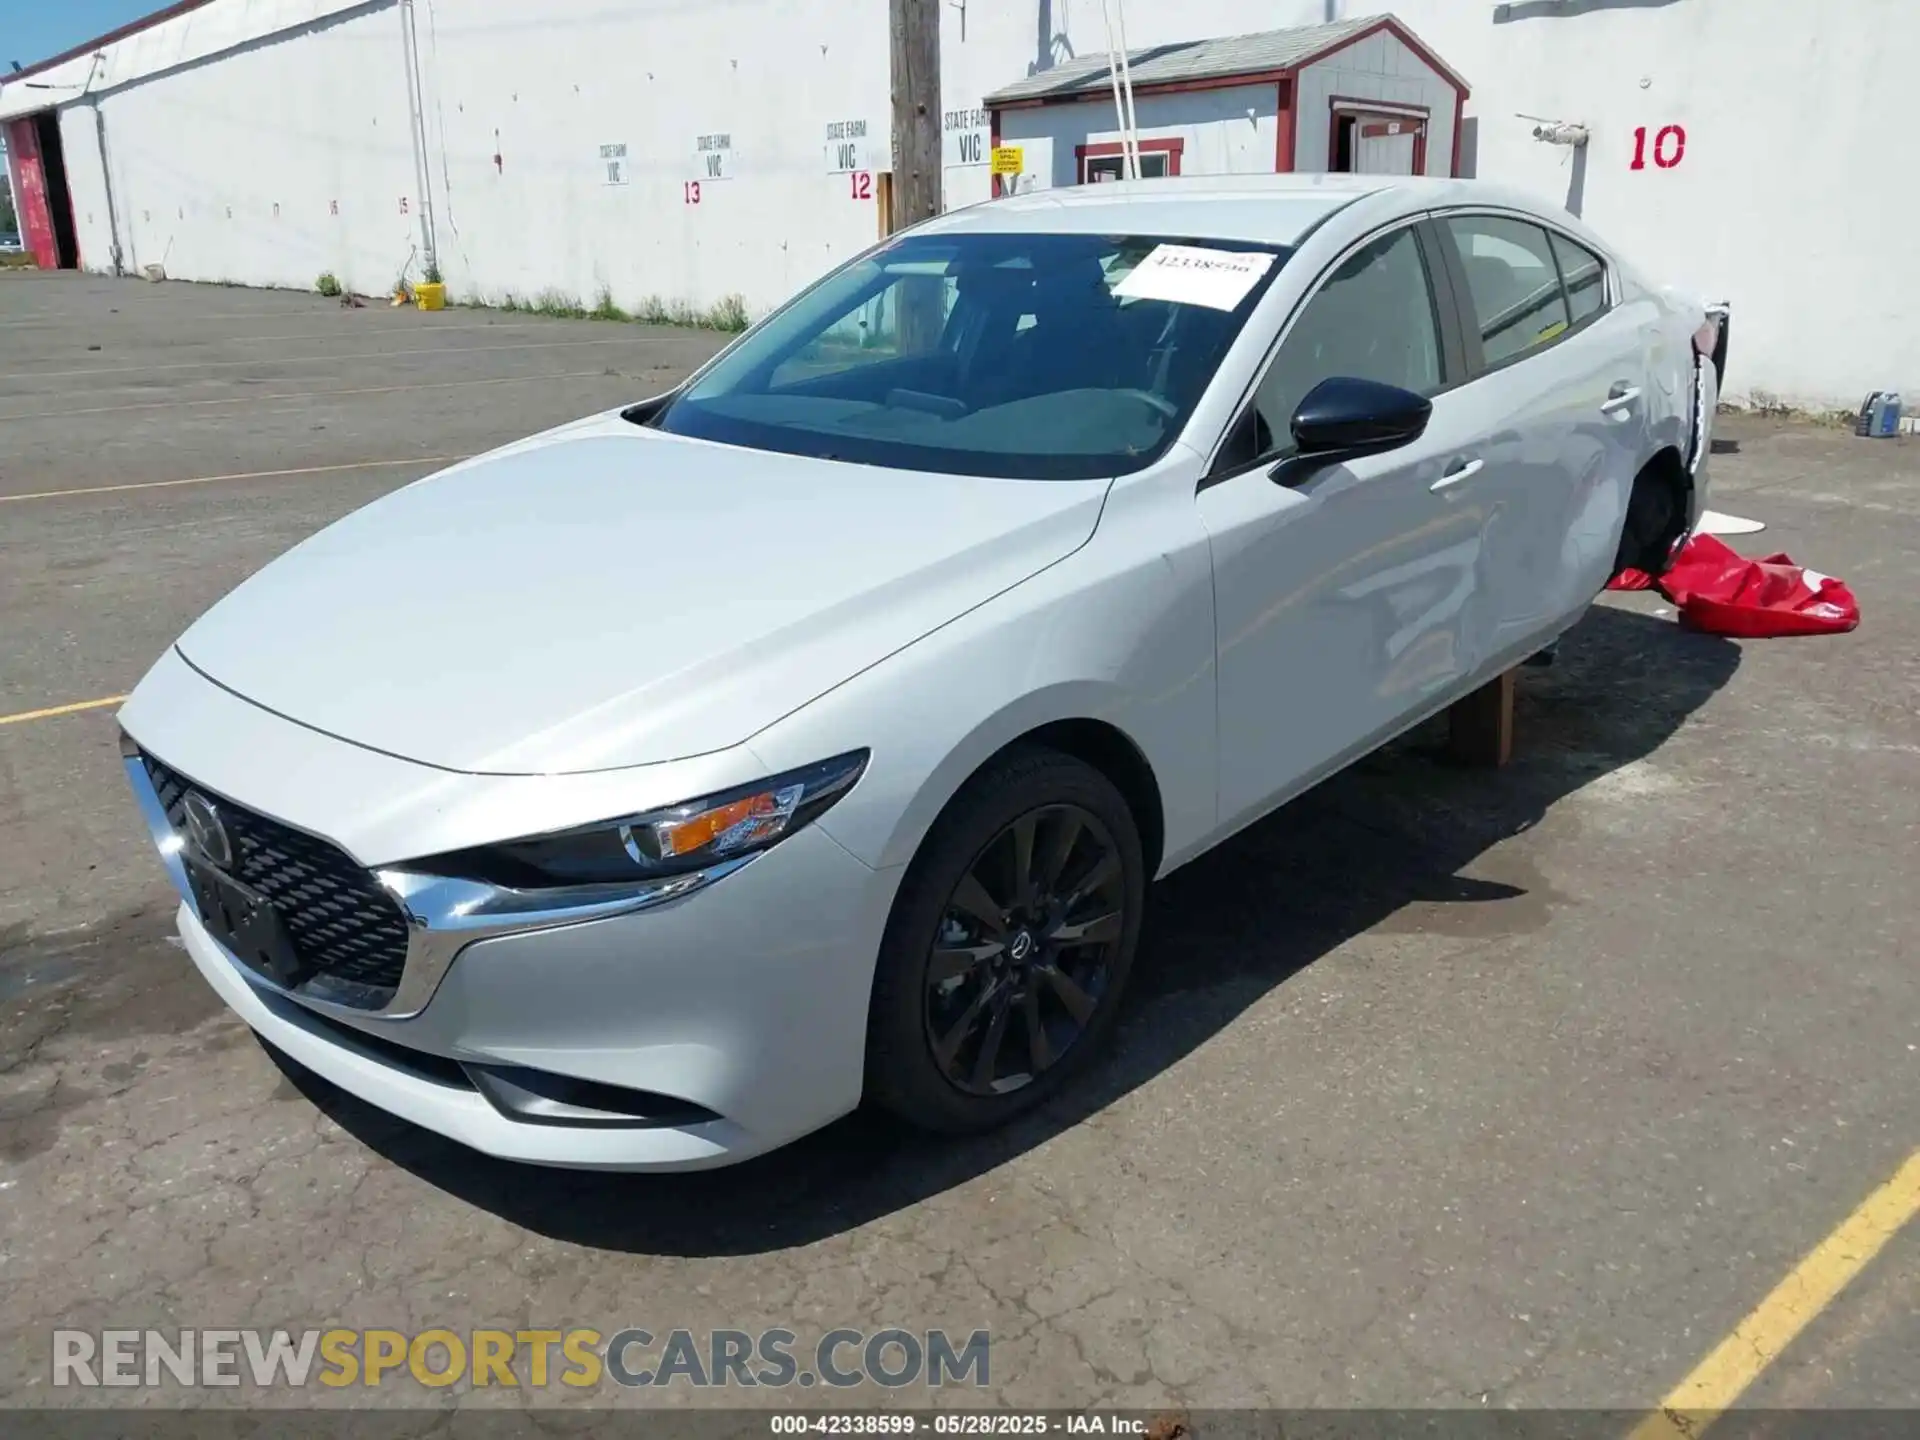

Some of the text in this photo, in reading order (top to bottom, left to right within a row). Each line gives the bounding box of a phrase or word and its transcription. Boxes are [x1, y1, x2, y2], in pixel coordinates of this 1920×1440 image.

[826, 119, 866, 140] STATE FARM
[944, 109, 969, 131] STATE
[838, 143, 856, 169] VIC
[959, 133, 981, 162] VIC
[1630, 124, 1686, 170] 10
[607, 161, 620, 182] VIC
[706, 154, 722, 177] VIC
[684, 181, 701, 204] 13
[851, 172, 871, 199] 12
